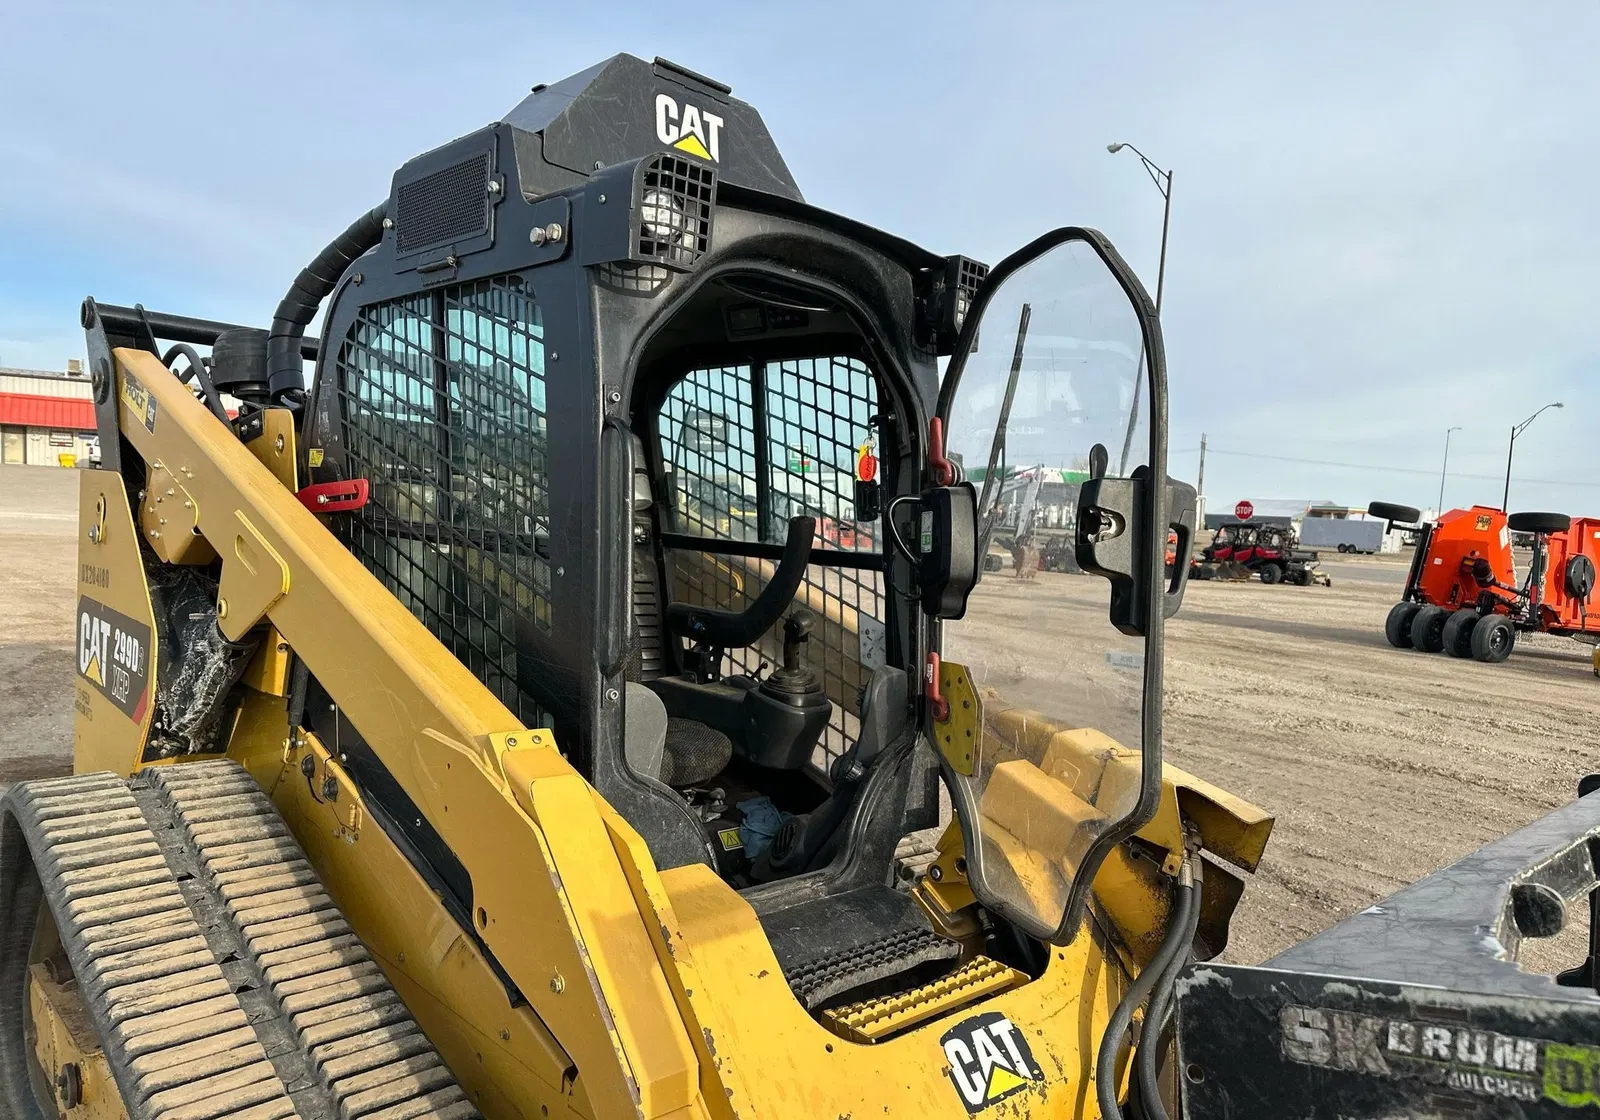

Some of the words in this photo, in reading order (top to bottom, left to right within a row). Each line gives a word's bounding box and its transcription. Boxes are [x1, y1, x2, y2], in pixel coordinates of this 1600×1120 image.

[655, 93, 724, 163] CAT
[1236, 506, 1253, 515] STOP
[79, 612, 111, 688] CAT
[943, 1018, 1033, 1105] CAT
